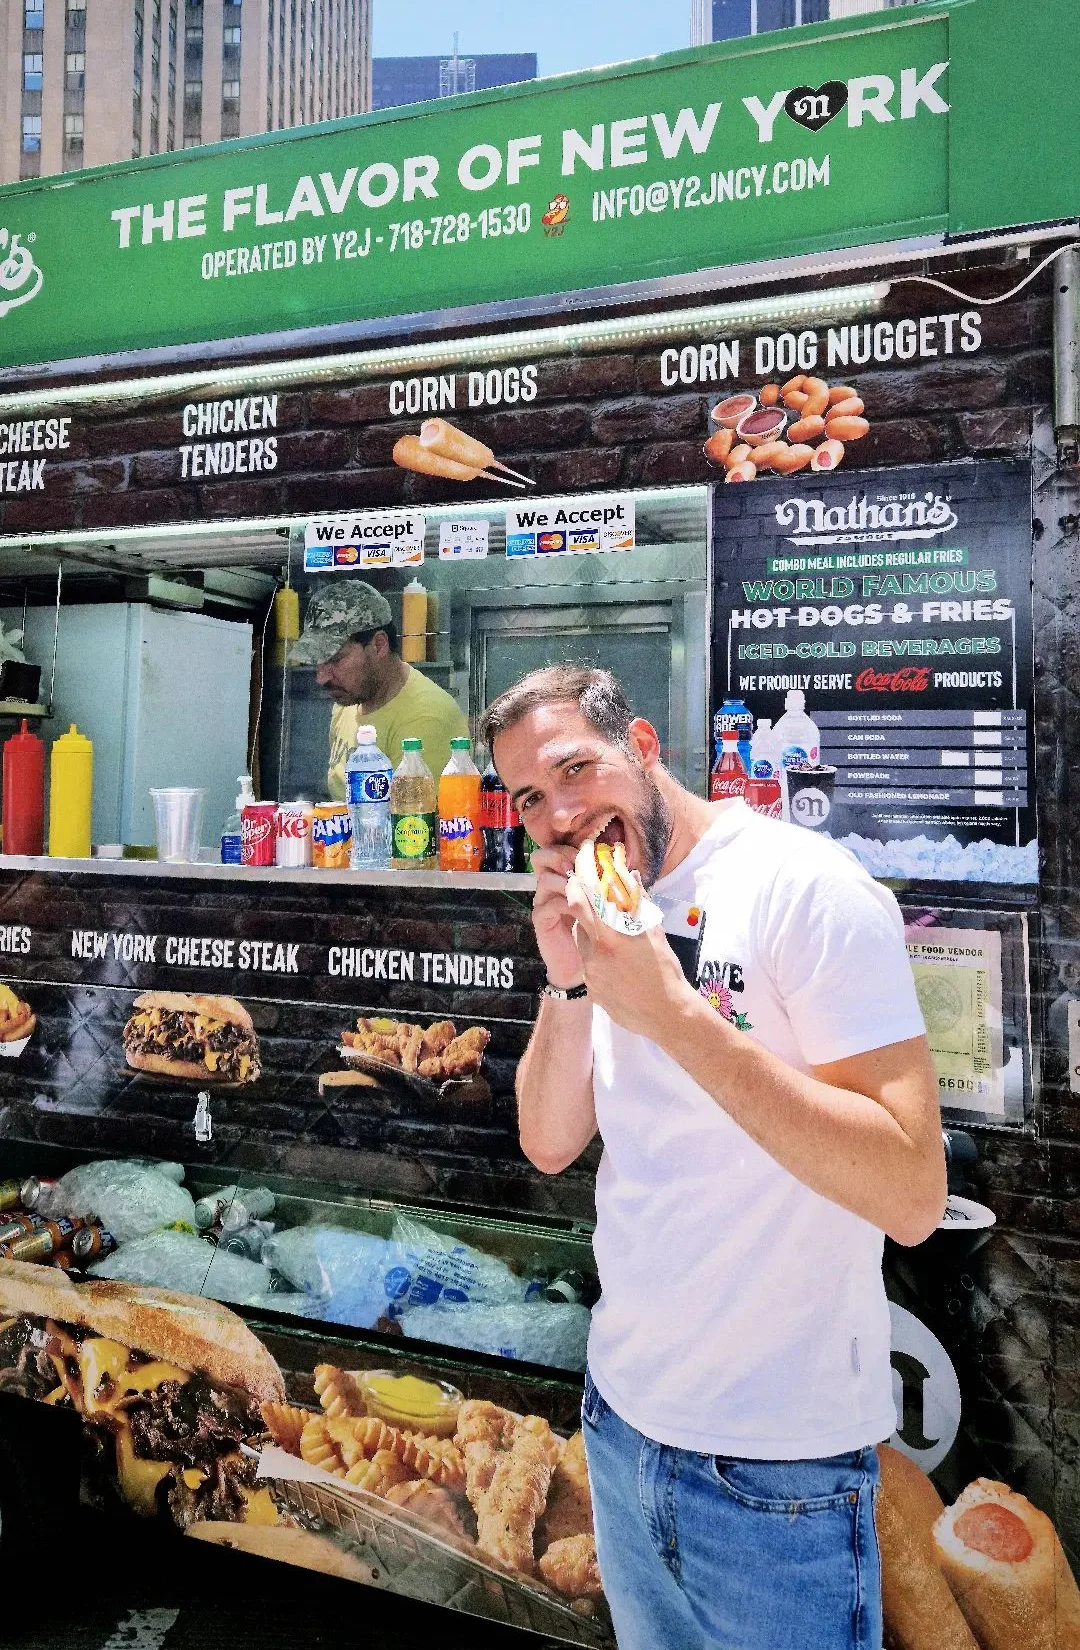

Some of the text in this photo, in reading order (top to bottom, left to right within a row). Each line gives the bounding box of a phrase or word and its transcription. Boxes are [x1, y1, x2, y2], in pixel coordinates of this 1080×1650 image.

[111, 194, 208, 248] THE
[222, 153, 441, 233] FLAVOR
[457, 135, 542, 192] OF
[561, 102, 722, 176] NEW
[592, 154, 830, 222] INFO@Y2JNCY.COM
[201, 240, 297, 280] OPERATED
[302, 236, 326, 266] BY
[333, 228, 371, 260] Y2J
[389, 203, 532, 252] 718-728-1530
[660, 311, 982, 387] CORN DOG NUGGETS
[389, 365, 538, 416] CORN DOGS
[182, 394, 278, 437] CHICKEN
[0, 417, 72, 454] CHEESE
[179, 437, 278, 479] TENDERS
[516, 504, 625, 528] We Accept
[774, 492, 958, 533] Nathan's
[316, 520, 414, 541] We Accept
[573, 534, 595, 544] VISA
[367, 549, 386, 558] VISA
[773, 550, 962, 572] COMBO MEAL INCLUDES REGULAR FRIES
[742, 569, 997, 602] WORLD FAMOUS
[731, 598, 1013, 629] HOT DOGS & FRIES
[738, 637, 1001, 660] ICED-COLD BEVERAGES
[739, 675, 757, 690] WE
[758, 673, 811, 690] PRODULY
[813, 672, 852, 689] SERVE
[934, 670, 1002, 687] PRODUCTS
[716, 713, 752, 724] POWER
[847, 714, 903, 722] BOTTLED SODA
[847, 753, 909, 761] BOTTLED WATER
[368, 776, 386, 784] Pure
[864, 792, 907, 800] FASHIONED
[440, 818, 474, 834] FANTA
[71, 930, 300, 974] NEW YORK CHEESE STEAK
[921, 945, 945, 954] FOOD
[947, 947, 983, 957] VENDOR
[328, 946, 514, 989] CHICKEN TENDERS
[699, 960, 745, 993] OVE
